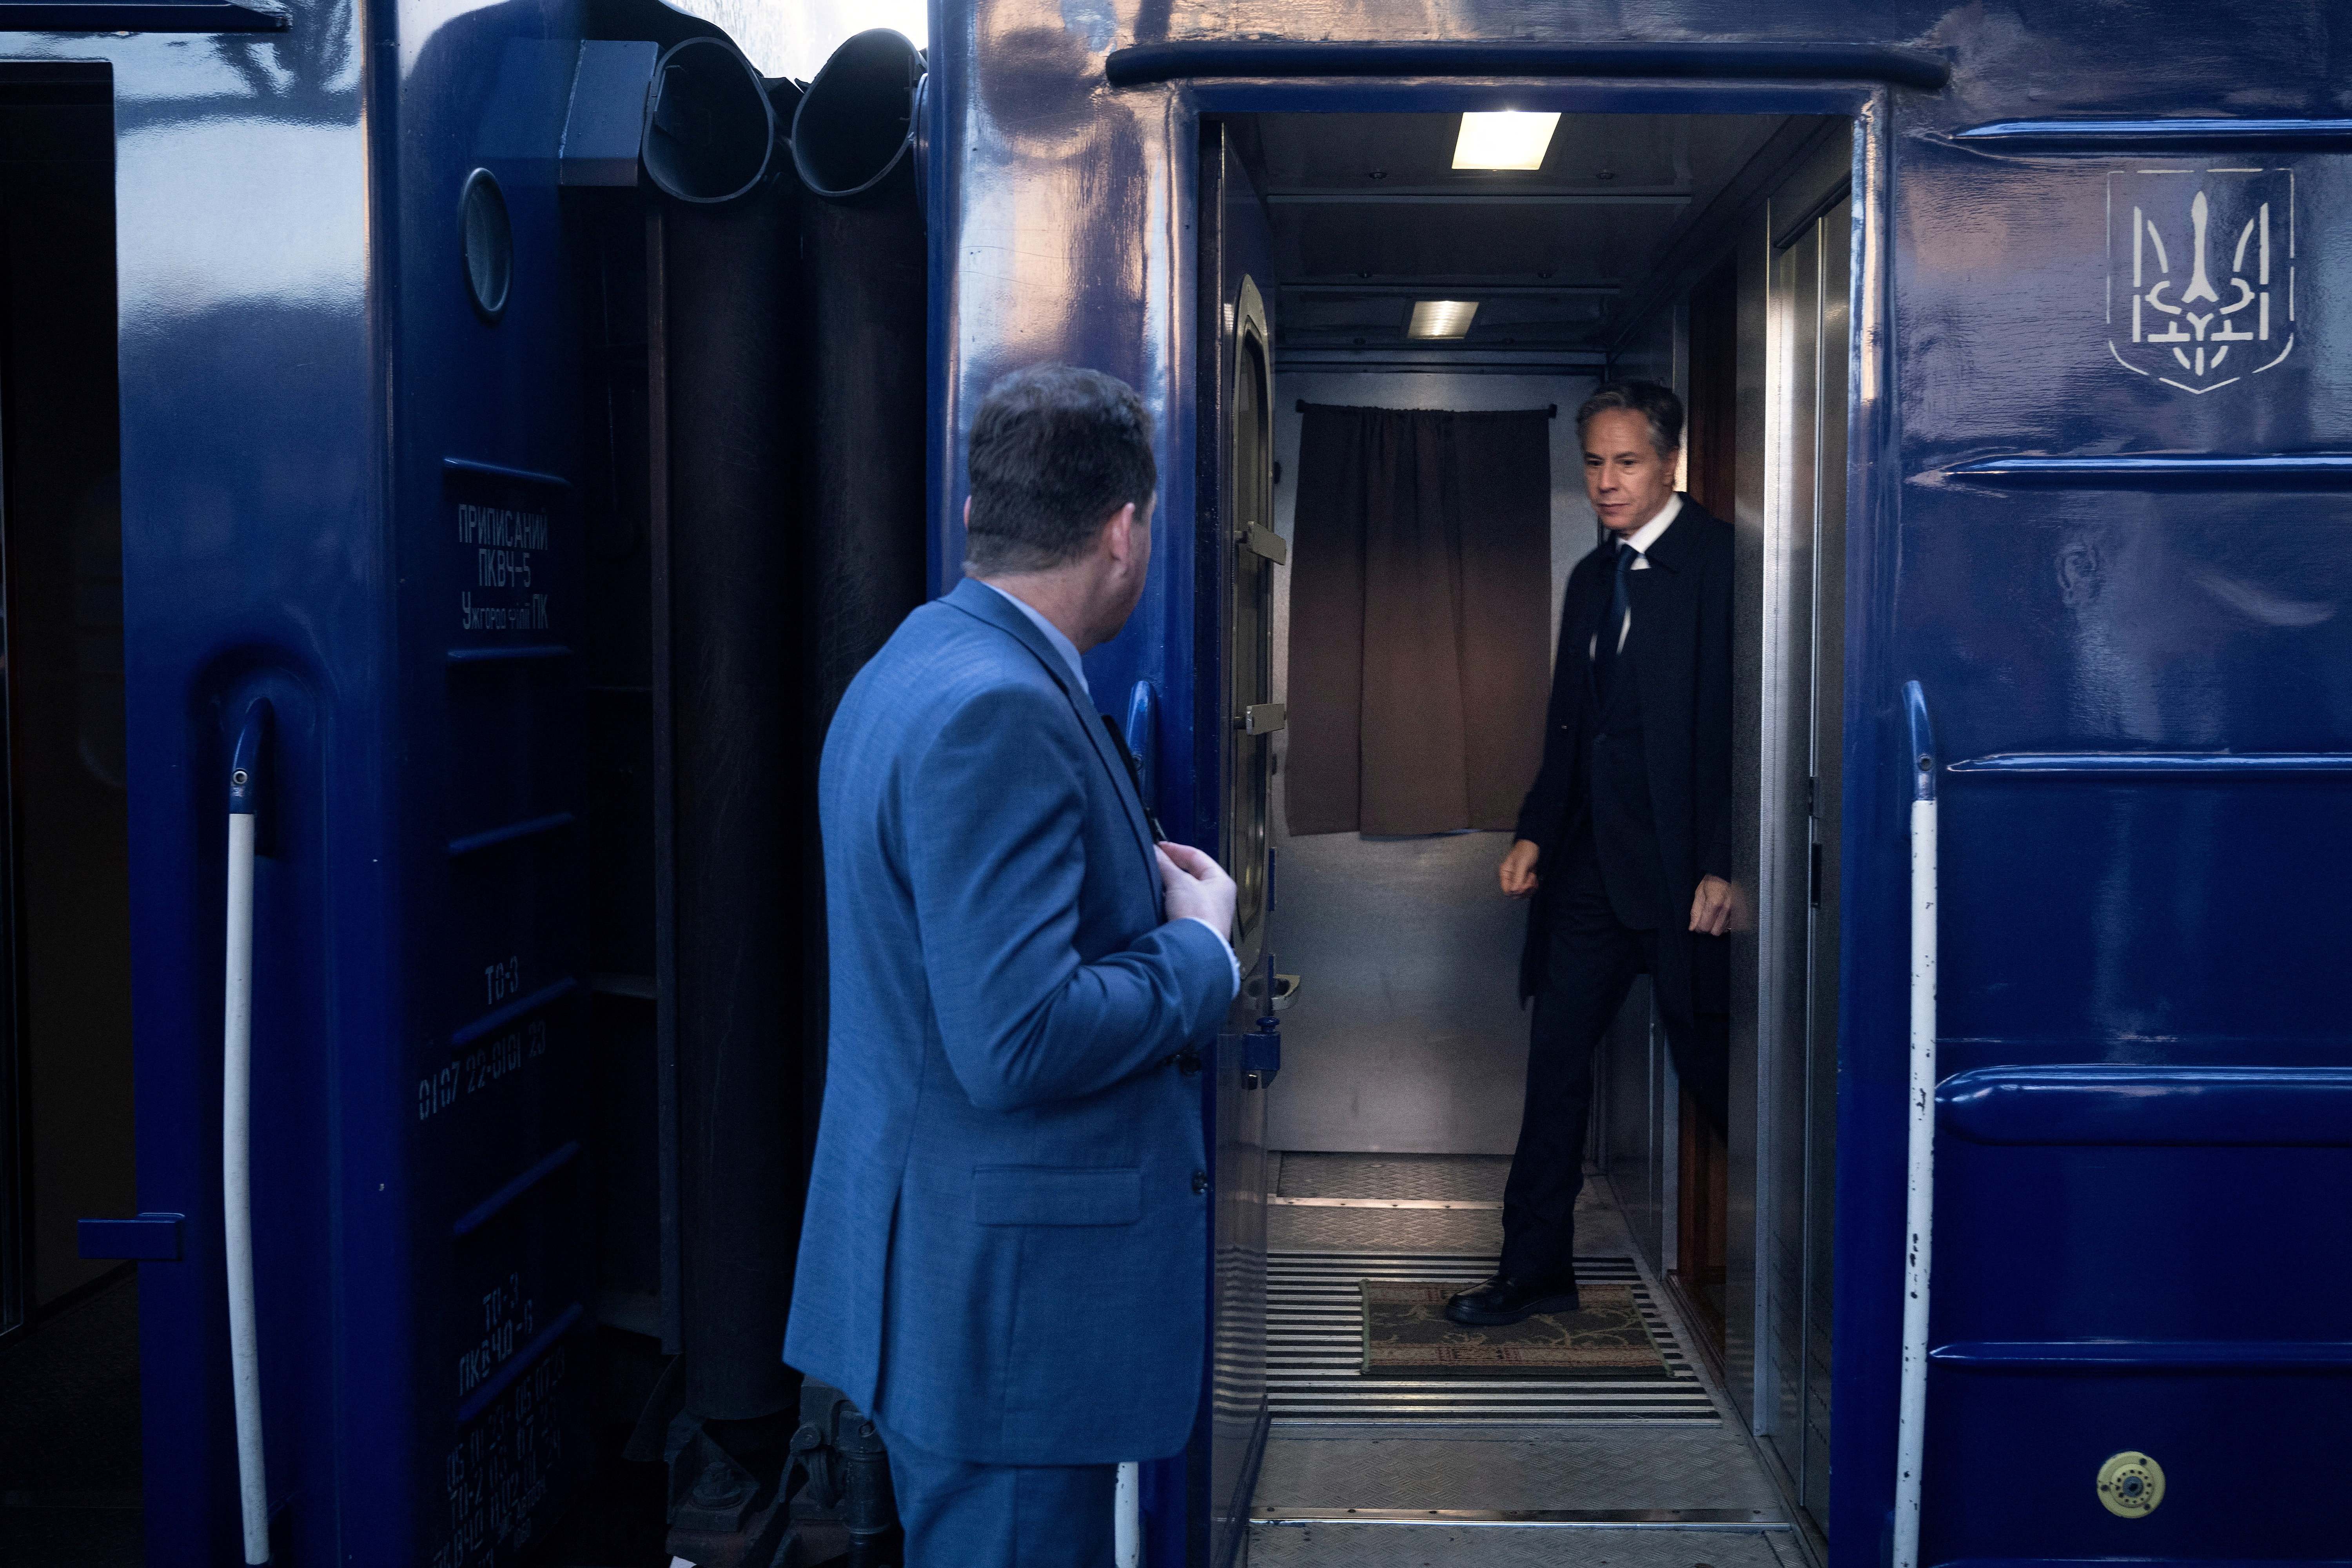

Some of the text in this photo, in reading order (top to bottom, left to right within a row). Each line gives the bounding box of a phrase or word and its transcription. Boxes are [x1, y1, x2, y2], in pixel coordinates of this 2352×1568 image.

[458, 503, 548, 550] ПРИПИСАНИЙ
[478, 548, 531, 588] ПКВЧ-5
[532, 594, 549, 629] ПК
[485, 955, 519, 1005] ТО-3
